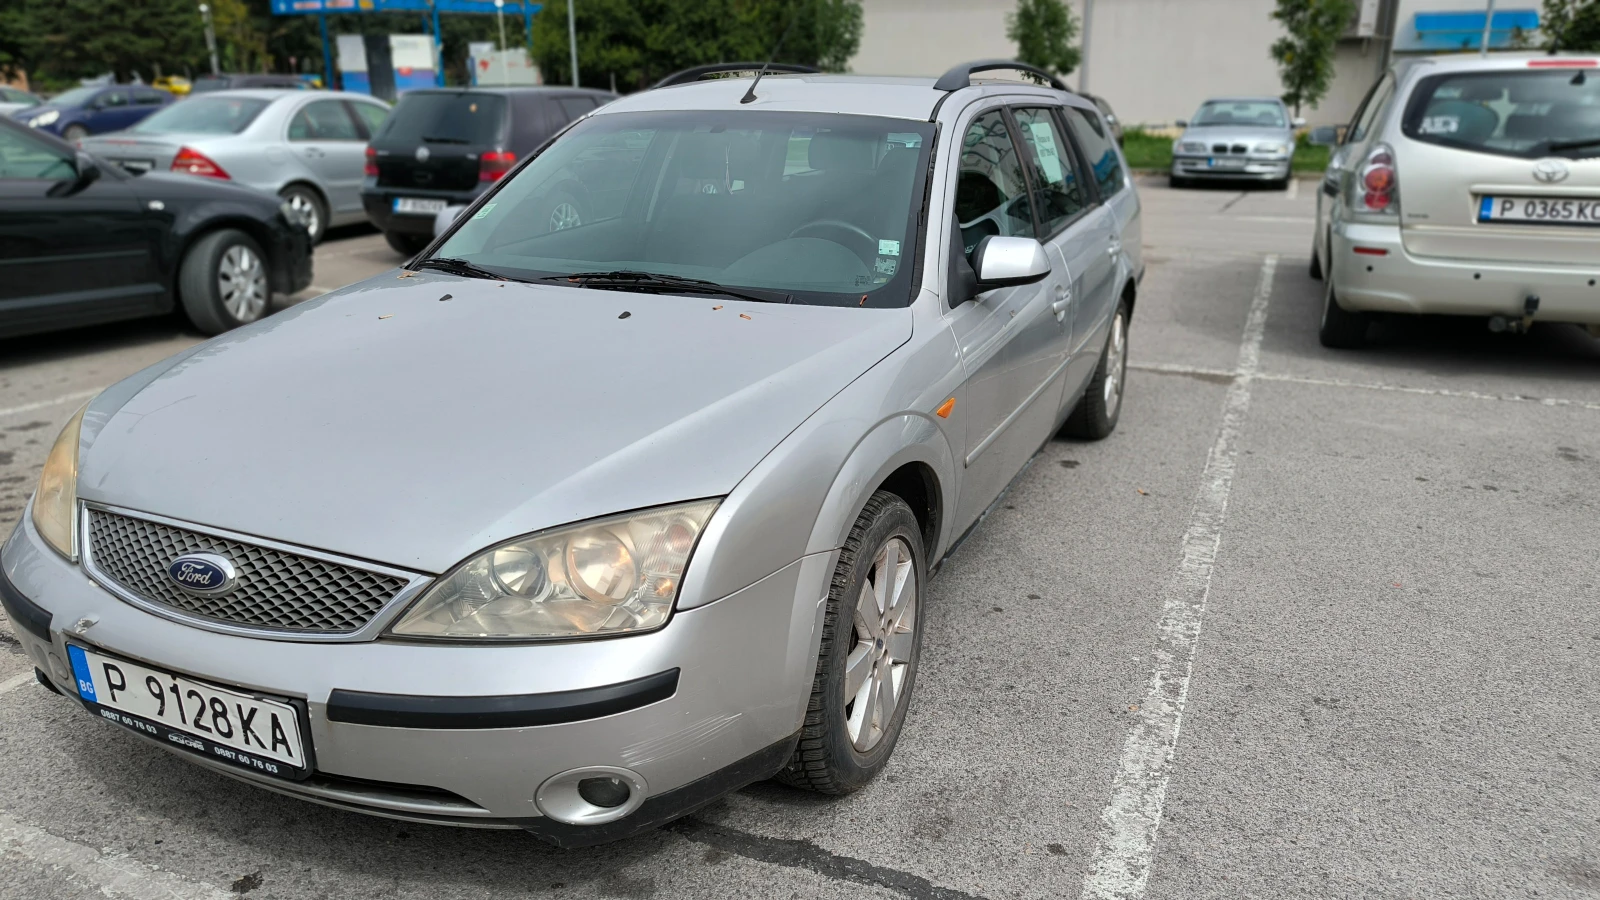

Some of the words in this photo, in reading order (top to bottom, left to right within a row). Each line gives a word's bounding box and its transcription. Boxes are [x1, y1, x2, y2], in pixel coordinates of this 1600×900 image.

[1500, 199, 1514, 216] P
[177, 562, 212, 585] Ford
[79, 680, 94, 693] BG
[102, 662, 126, 702] P
[101, 709, 120, 722] 0887
[122, 716, 133, 727] 60
[134, 719, 145, 731] 76
[147, 723, 158, 734] 03
[214, 746, 236, 760] 0887
[238, 752, 251, 765] 60
[252, 757, 264, 770] 76
[265, 761, 279, 774] 03
